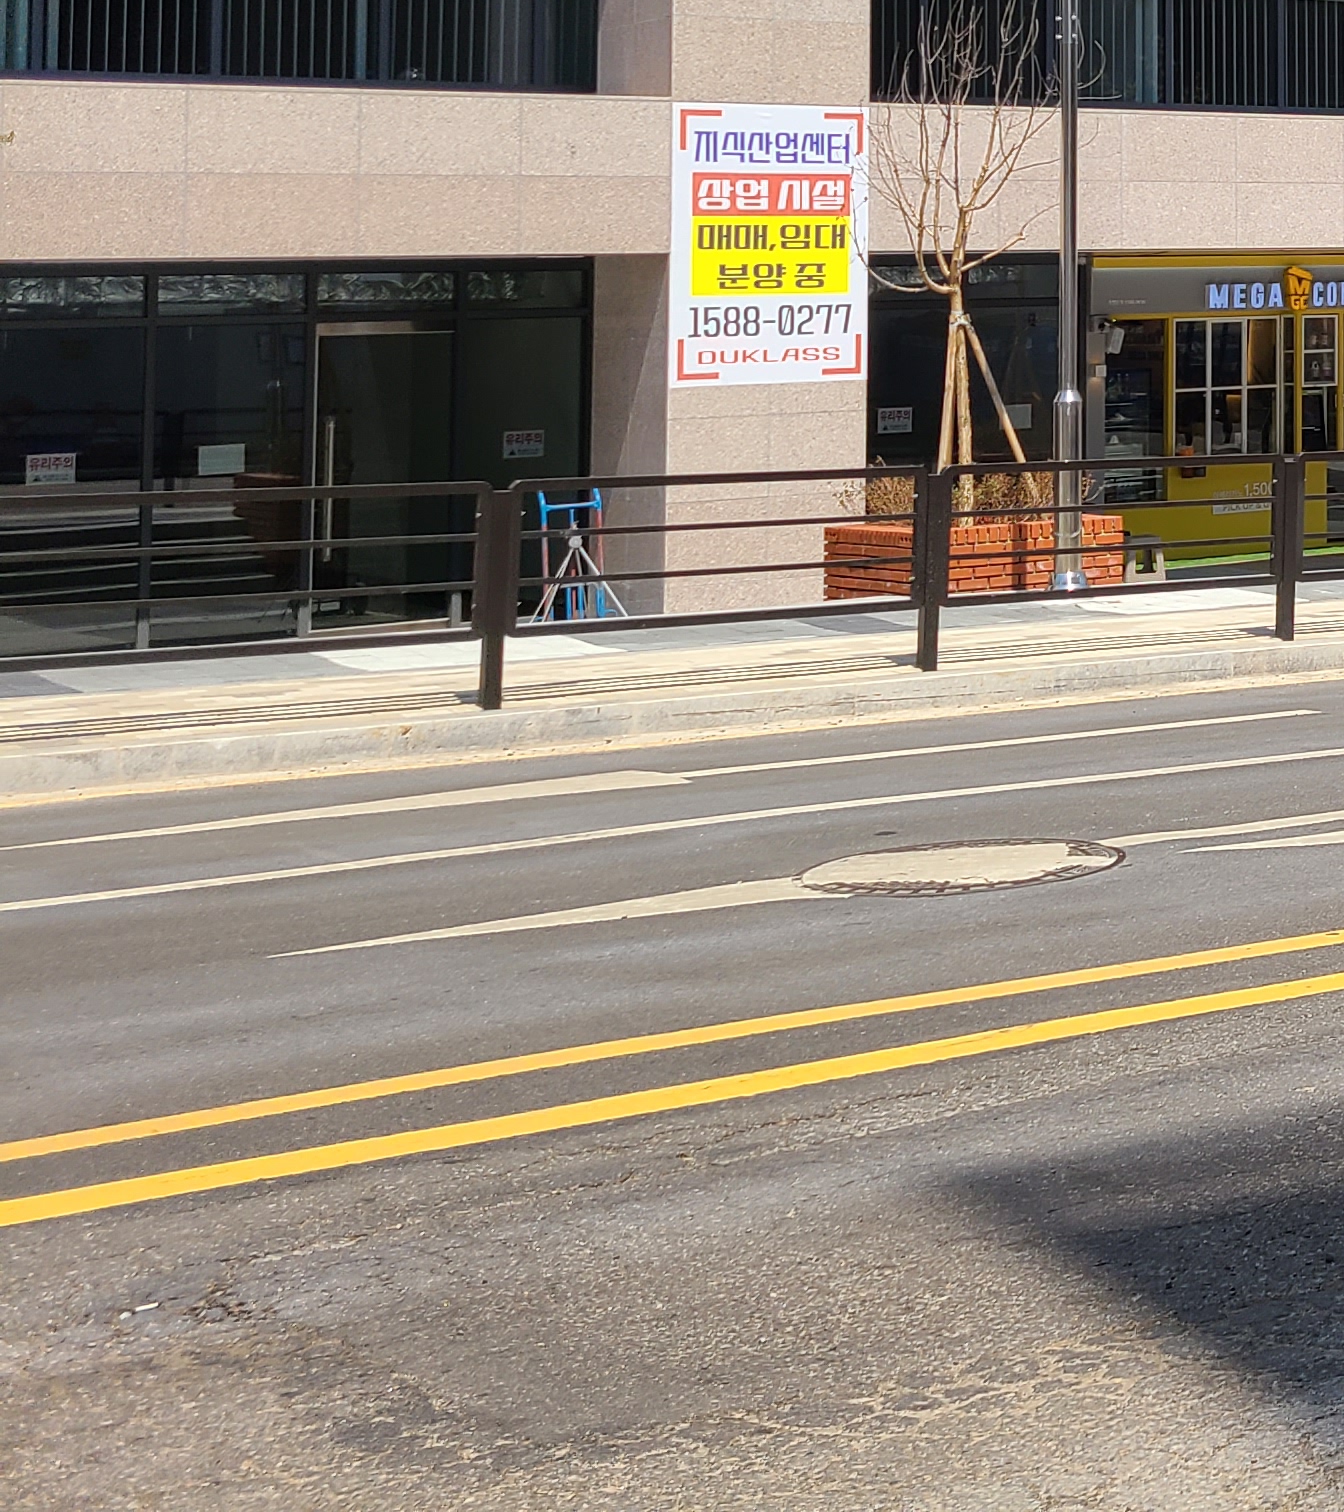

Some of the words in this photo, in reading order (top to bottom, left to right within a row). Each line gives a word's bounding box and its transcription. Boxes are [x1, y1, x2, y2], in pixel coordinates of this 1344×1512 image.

[694, 131, 850, 164] 지식산업센터
[697, 179, 769, 210] 상업
[777, 179, 845, 210] 시설
[697, 224, 846, 251] 매매,임대
[716, 264, 788, 289] 분양
[794, 263, 826, 288] 중
[1208, 282, 1284, 309] MEGA
[688, 303, 852, 338] 1588-0277
[697, 347, 840, 365] DUKLASS
[506, 433, 543, 445] 유리주의
[29, 455, 74, 471] 유리주의
